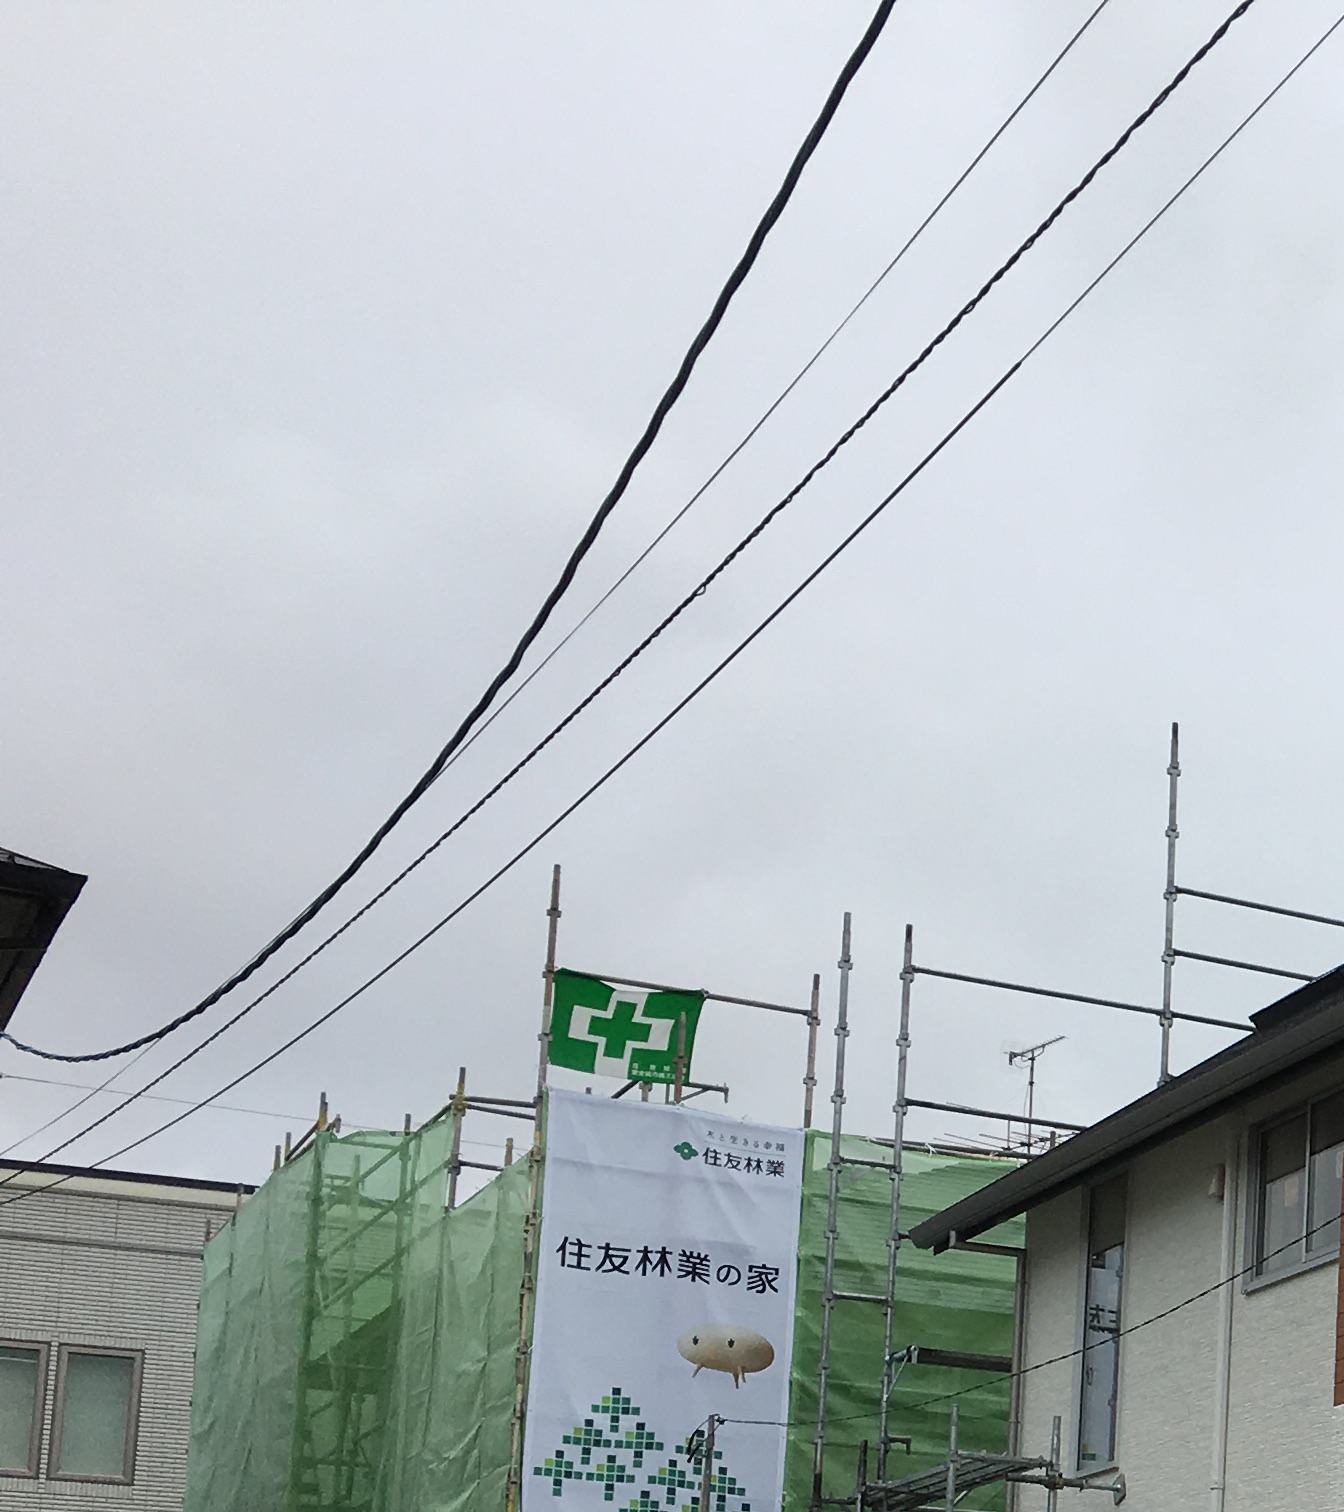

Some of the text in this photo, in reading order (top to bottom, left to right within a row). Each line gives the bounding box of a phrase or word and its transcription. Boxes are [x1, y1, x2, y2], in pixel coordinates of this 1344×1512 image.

[702, 1147, 785, 1178] 住友林業
[556, 1236, 780, 1294] 住友林業の家
